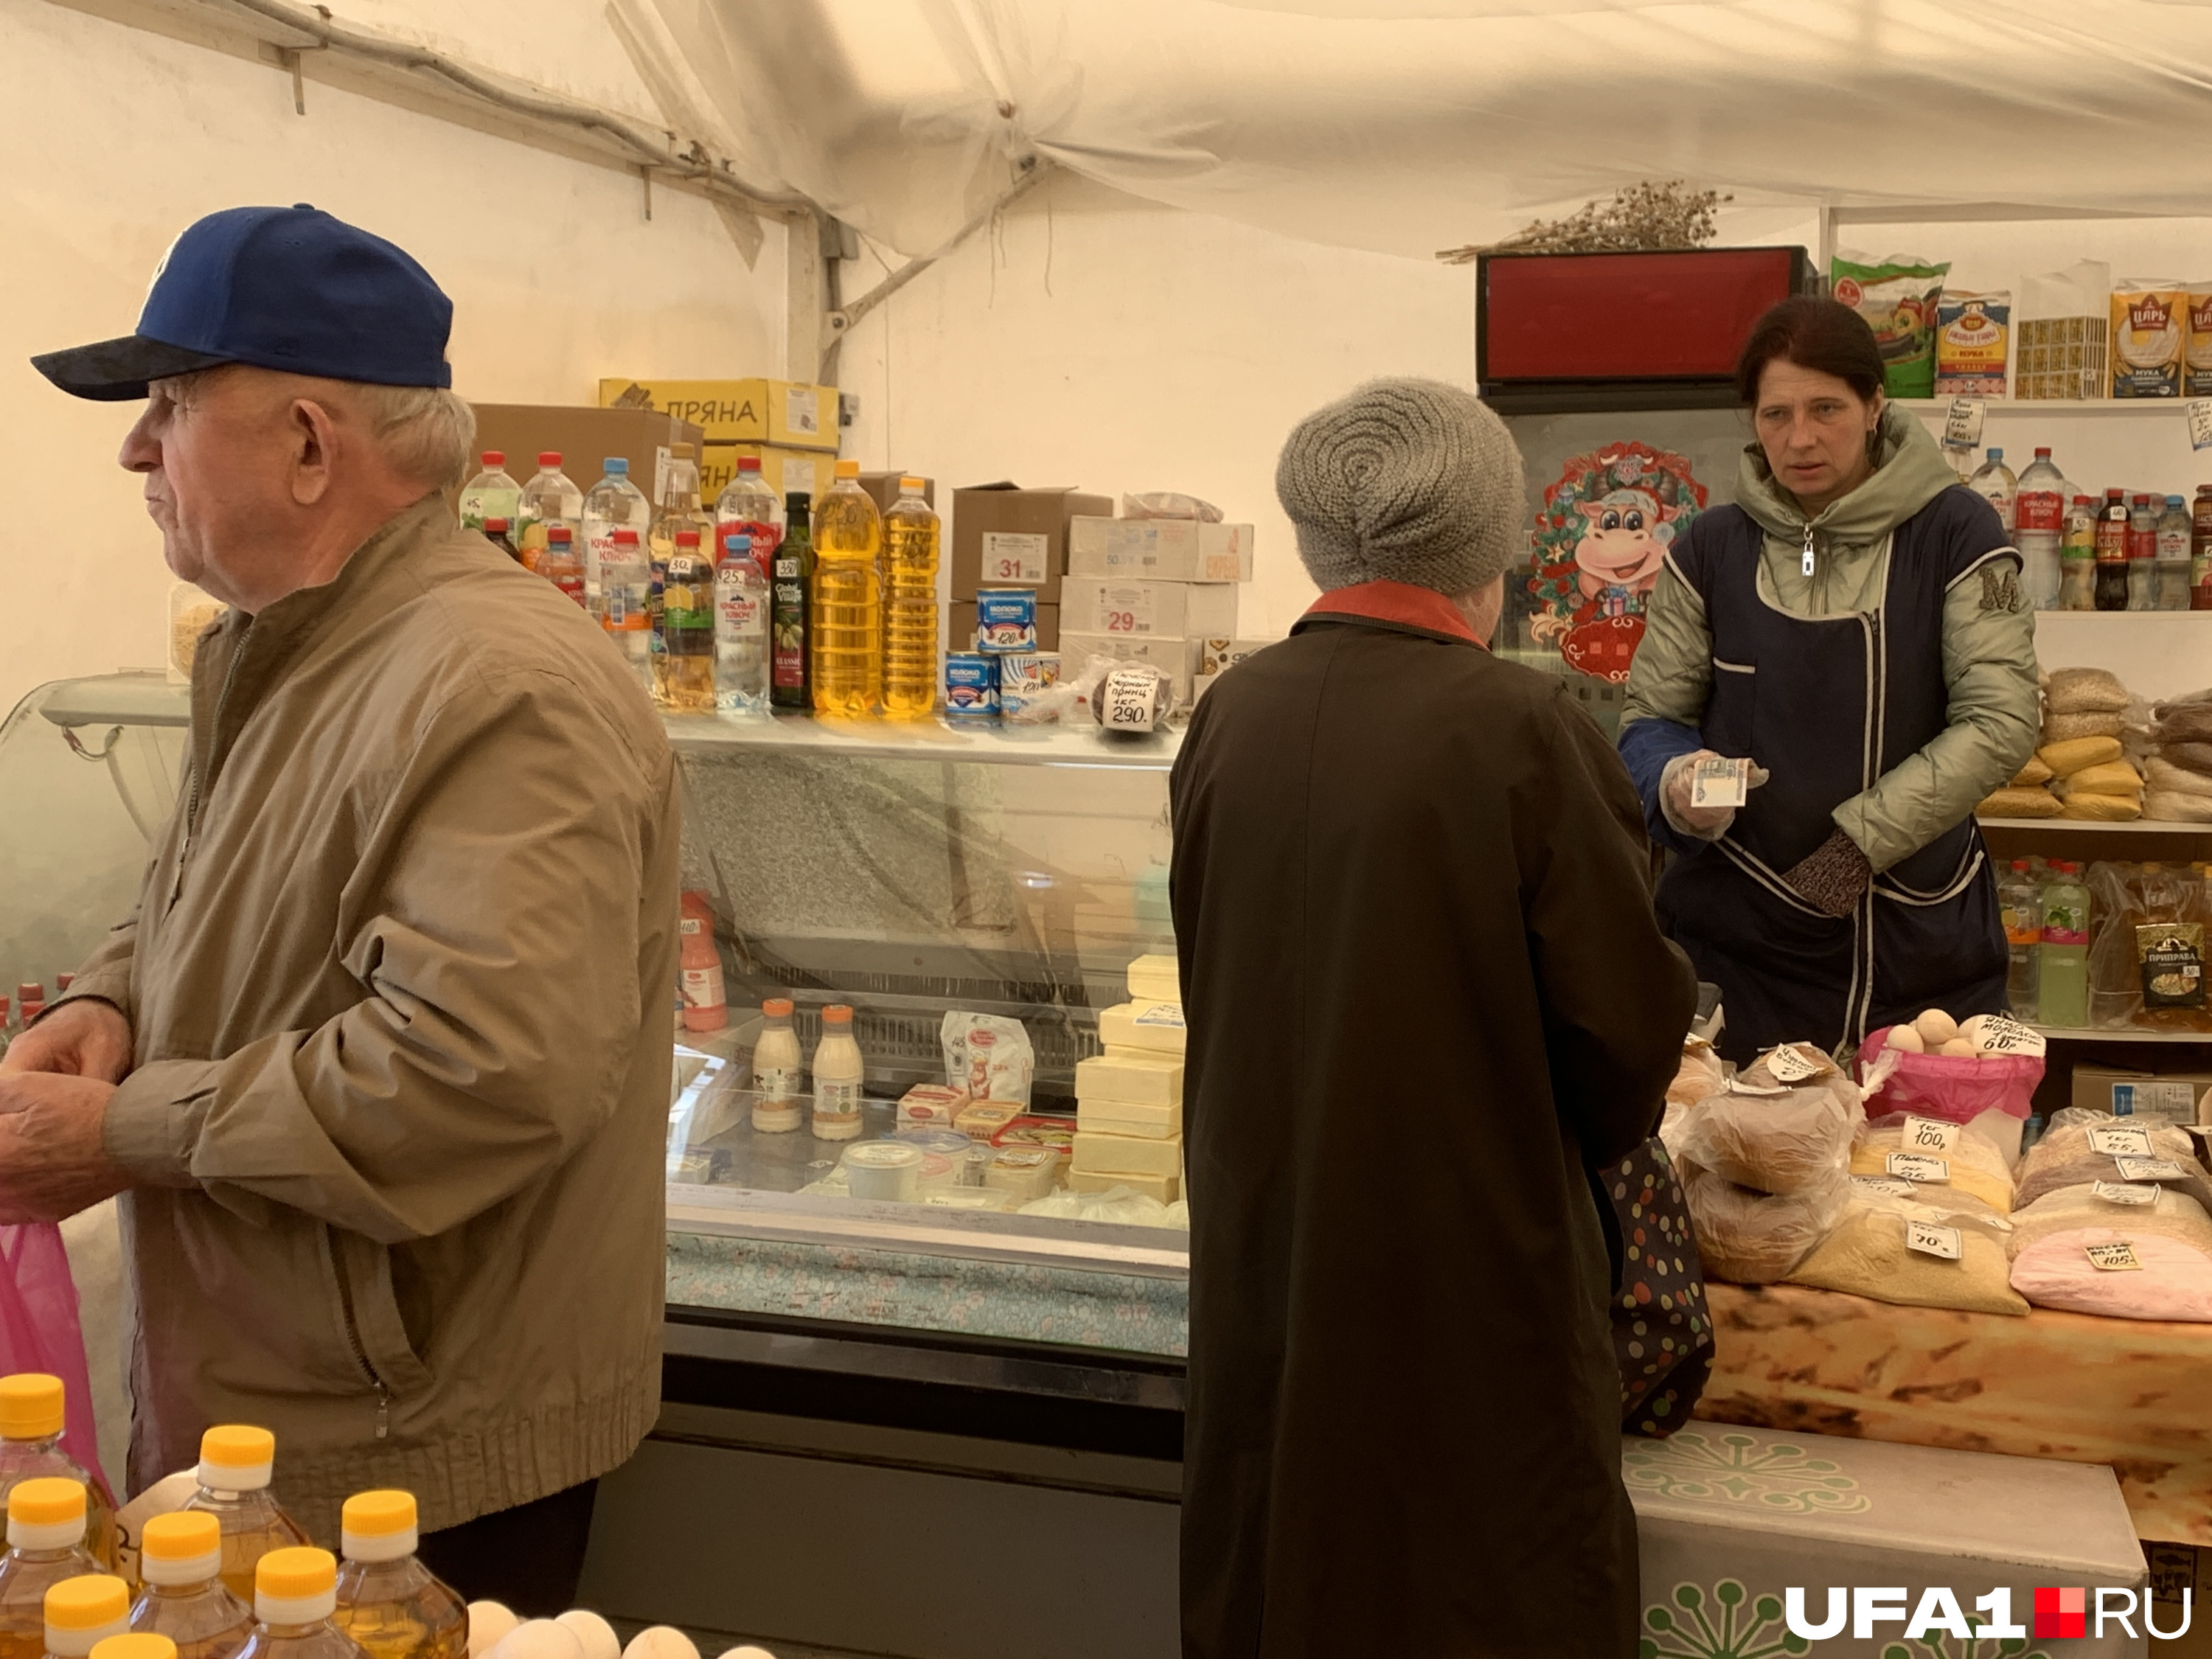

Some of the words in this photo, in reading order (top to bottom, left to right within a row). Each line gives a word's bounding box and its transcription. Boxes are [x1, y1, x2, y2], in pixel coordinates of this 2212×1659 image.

[2133, 310, 2166, 323] ЦАРЬ
[2024, 500, 2059, 509] КРАСНЫЙ
[999, 559, 1021, 578] 31
[720, 601, 757, 611] КРАСНЫЙ
[726, 611, 750, 619] КЛЮЧ
[1107, 611, 1135, 631] 29
[2149, 953, 2197, 962] ПРИПРАВА
